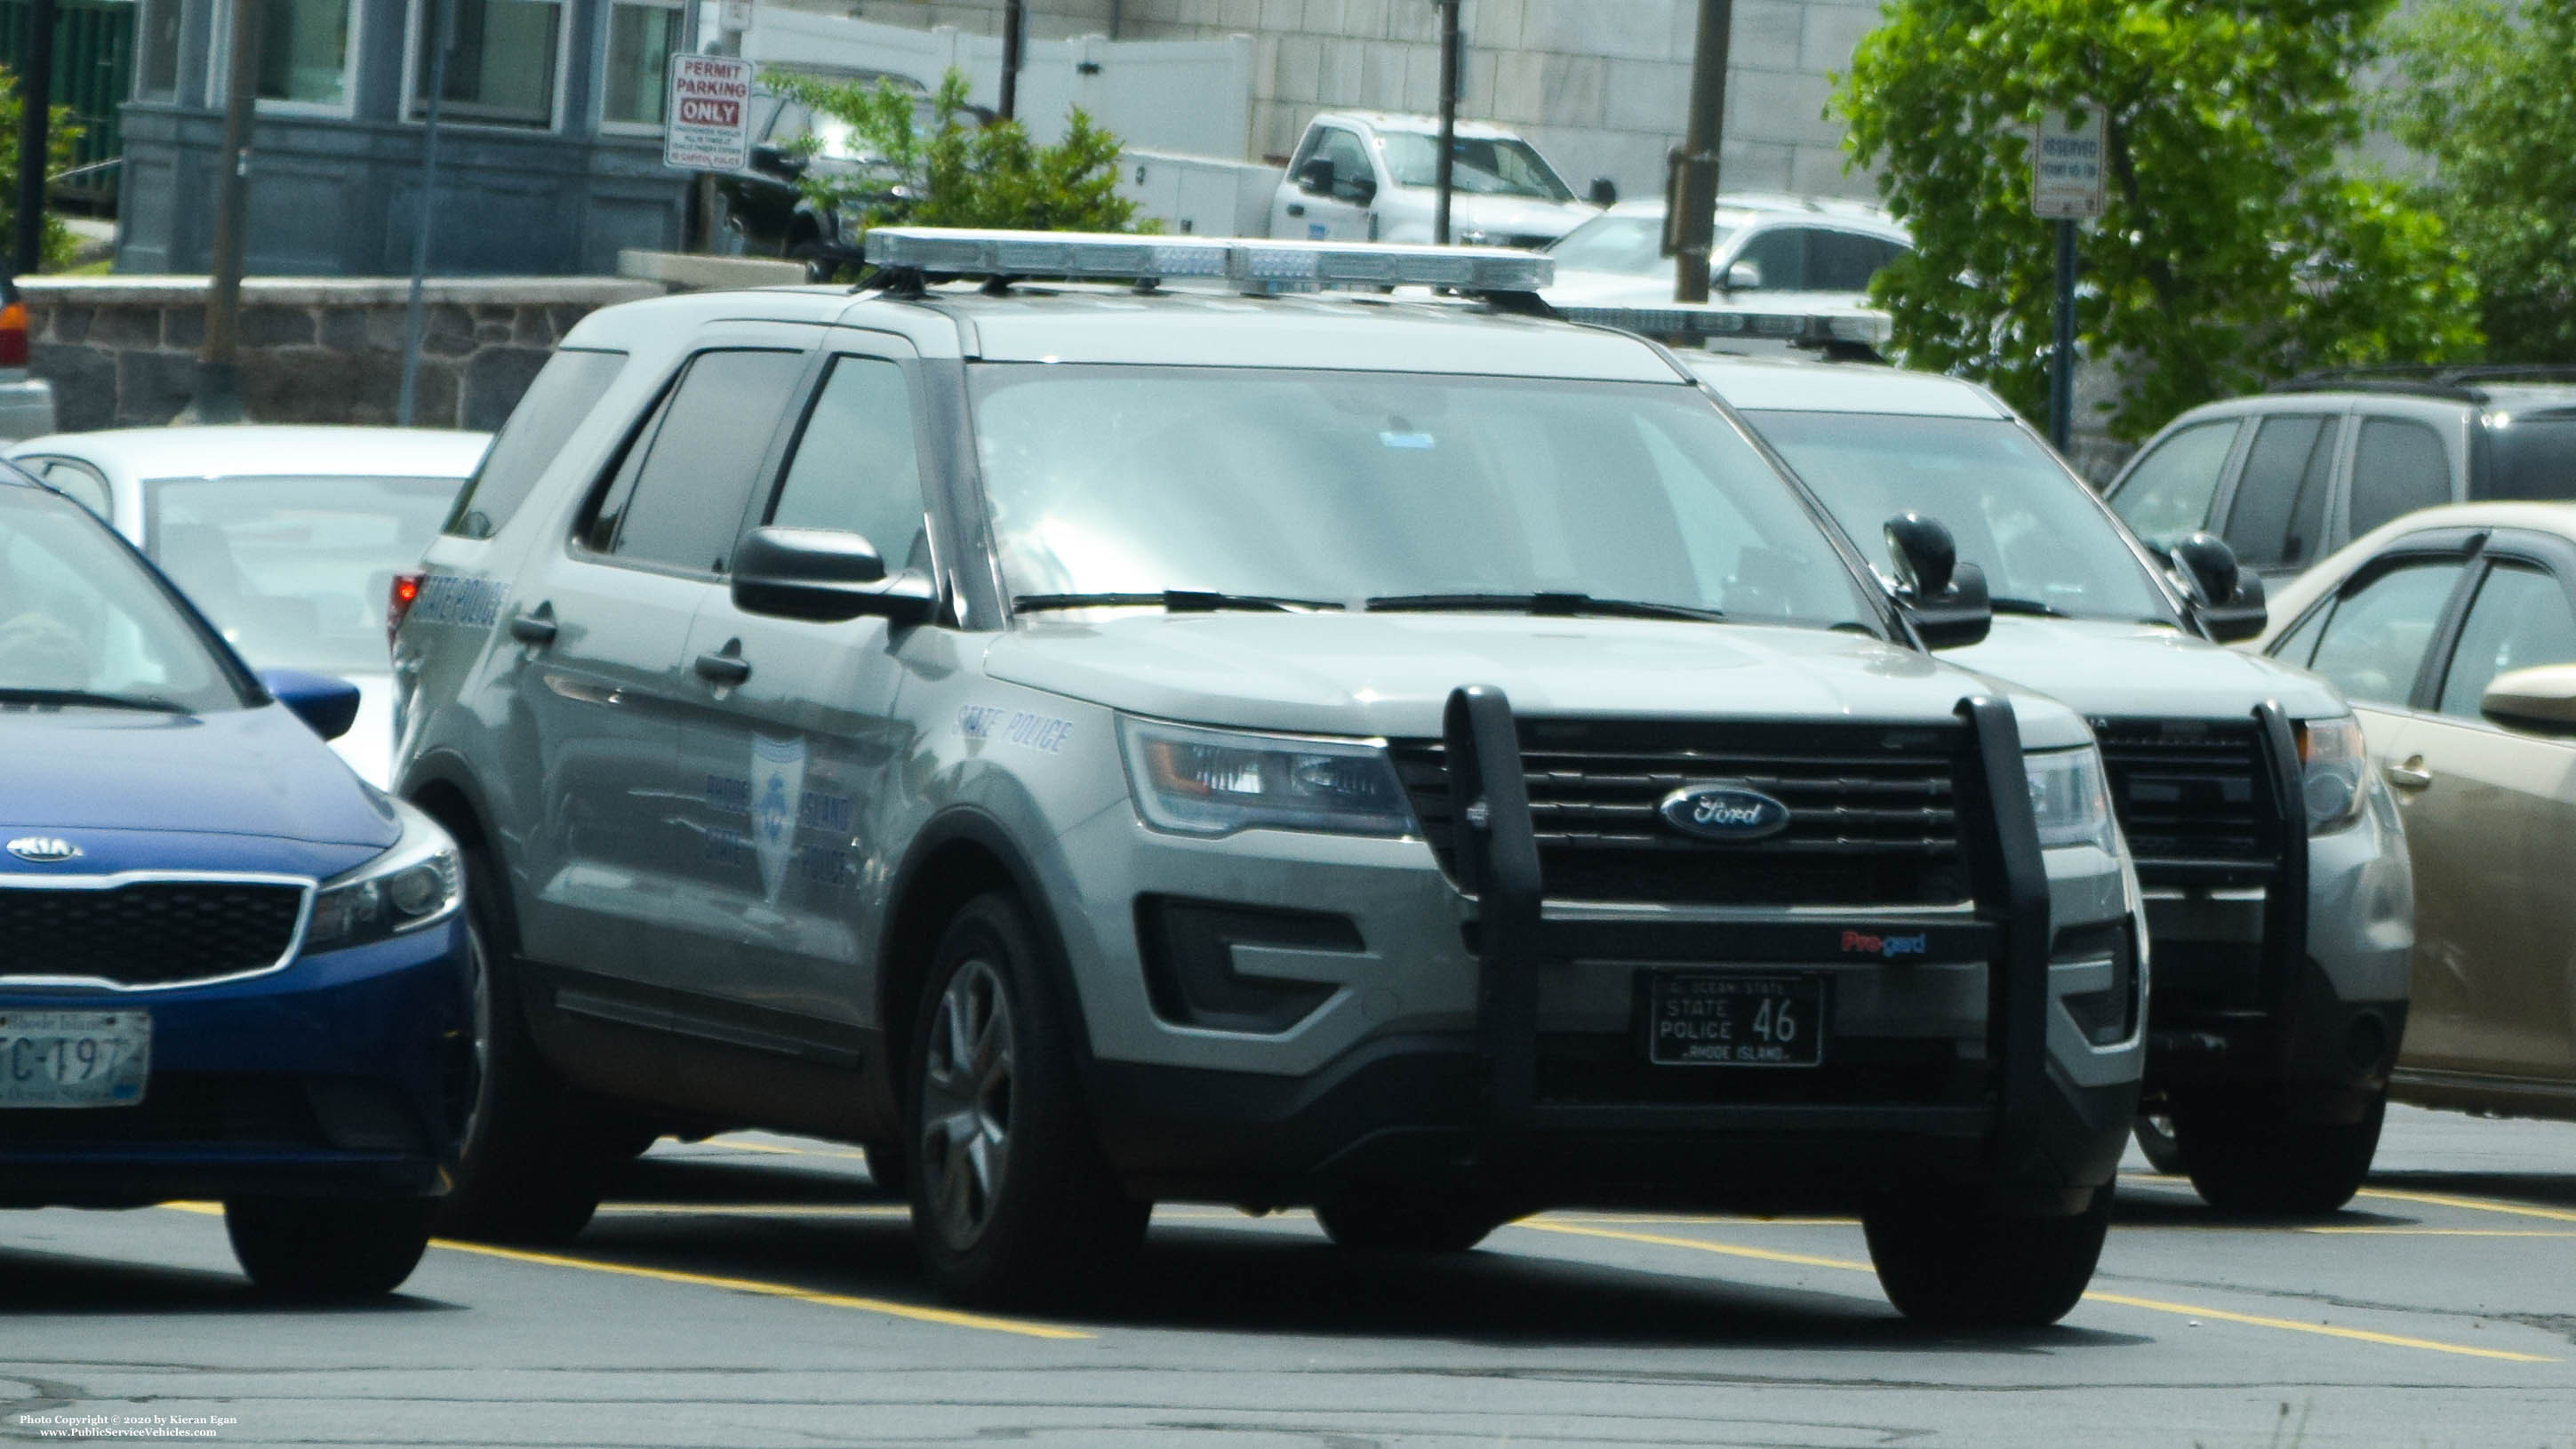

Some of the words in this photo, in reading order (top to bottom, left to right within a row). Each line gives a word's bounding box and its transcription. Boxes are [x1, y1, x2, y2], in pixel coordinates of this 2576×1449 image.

[684, 61, 741, 77] PERMIT
[676, 78, 747, 97] PARKING
[683, 100, 735, 122] ONLY
[1003, 710, 1073, 753] POLICE
[1694, 797, 1762, 824] Ford
[1667, 999, 1729, 1018] STATE
[1753, 997, 1796, 1042] 46
[1660, 1021, 1732, 1039] POLICE
[1690, 1045, 1732, 1061] RHODE
[1736, 1045, 1784, 1061] ISLAND
